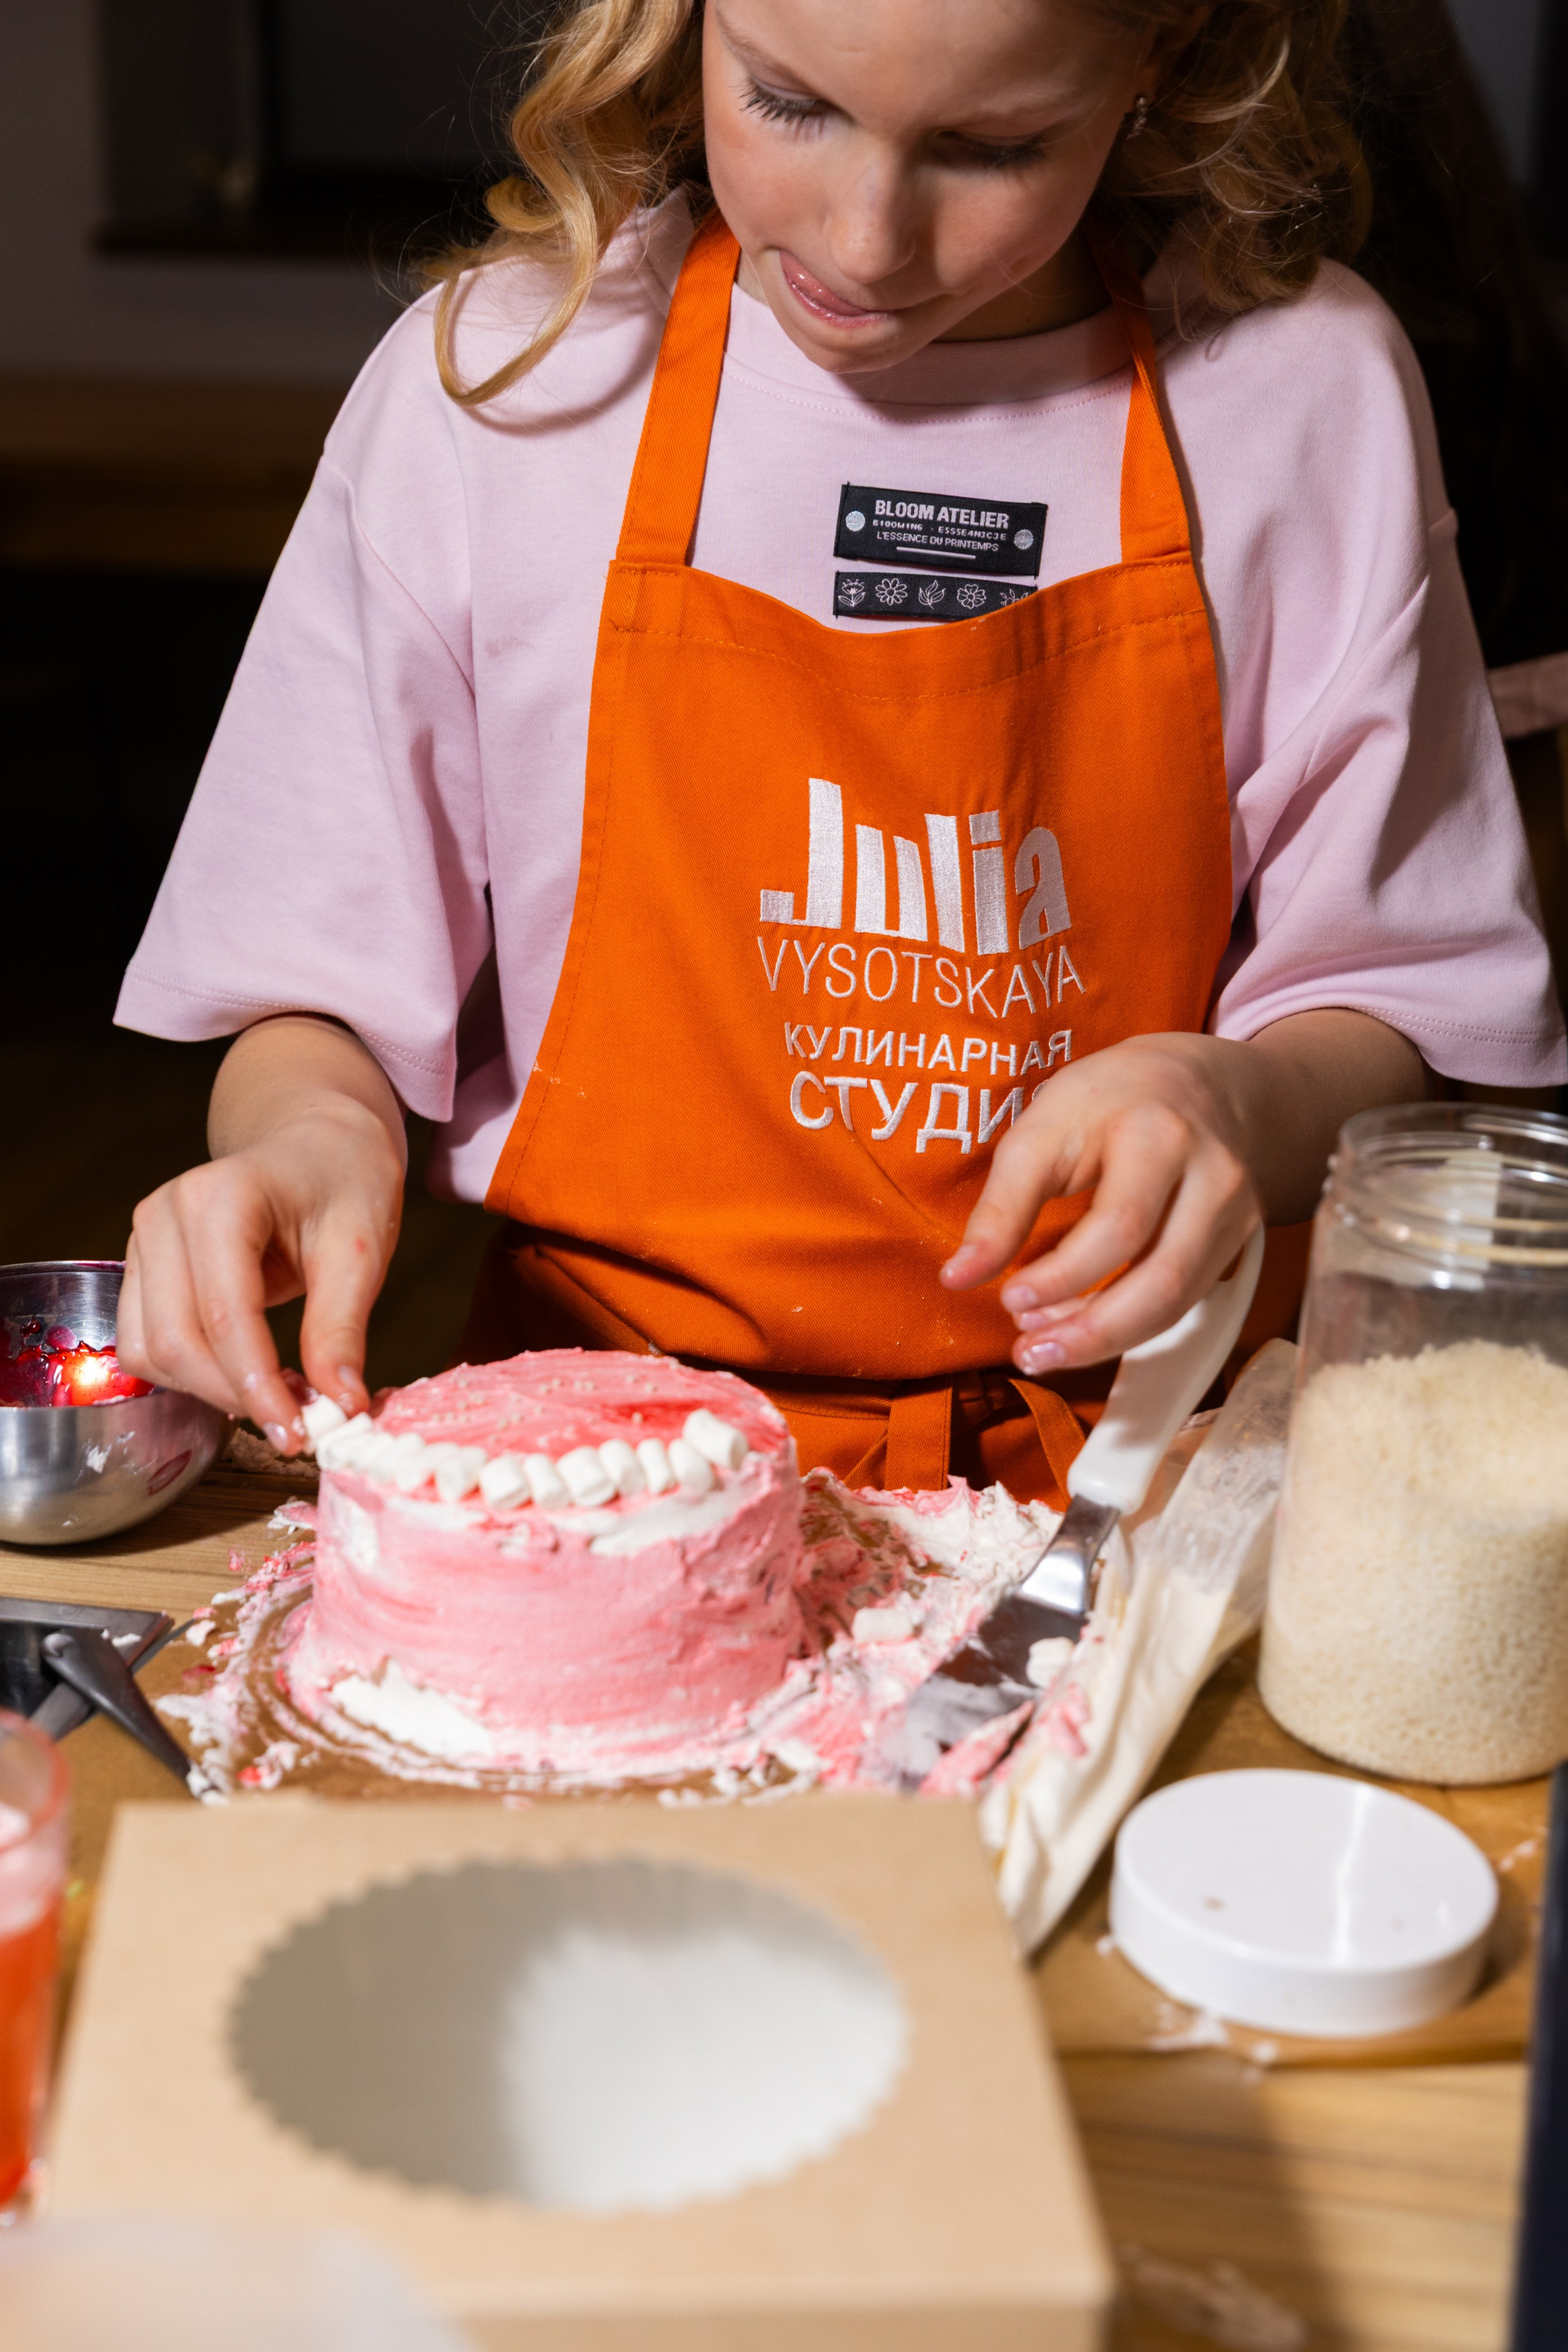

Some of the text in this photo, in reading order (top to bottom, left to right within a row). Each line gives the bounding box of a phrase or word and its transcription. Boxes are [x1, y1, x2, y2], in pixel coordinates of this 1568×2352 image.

[875, 500, 1009, 529] BLOOM ATELIER
[876, 531, 999, 551] L'ESSENCE DU PRINTEMPS
[760, 777, 1072, 956] Julia
[758, 936, 1087, 1018] VYSOTSKAYA
[785, 1022, 1072, 1076] КУЛИНАРНАЯ
[790, 1071, 1049, 1154] СТУДИ
